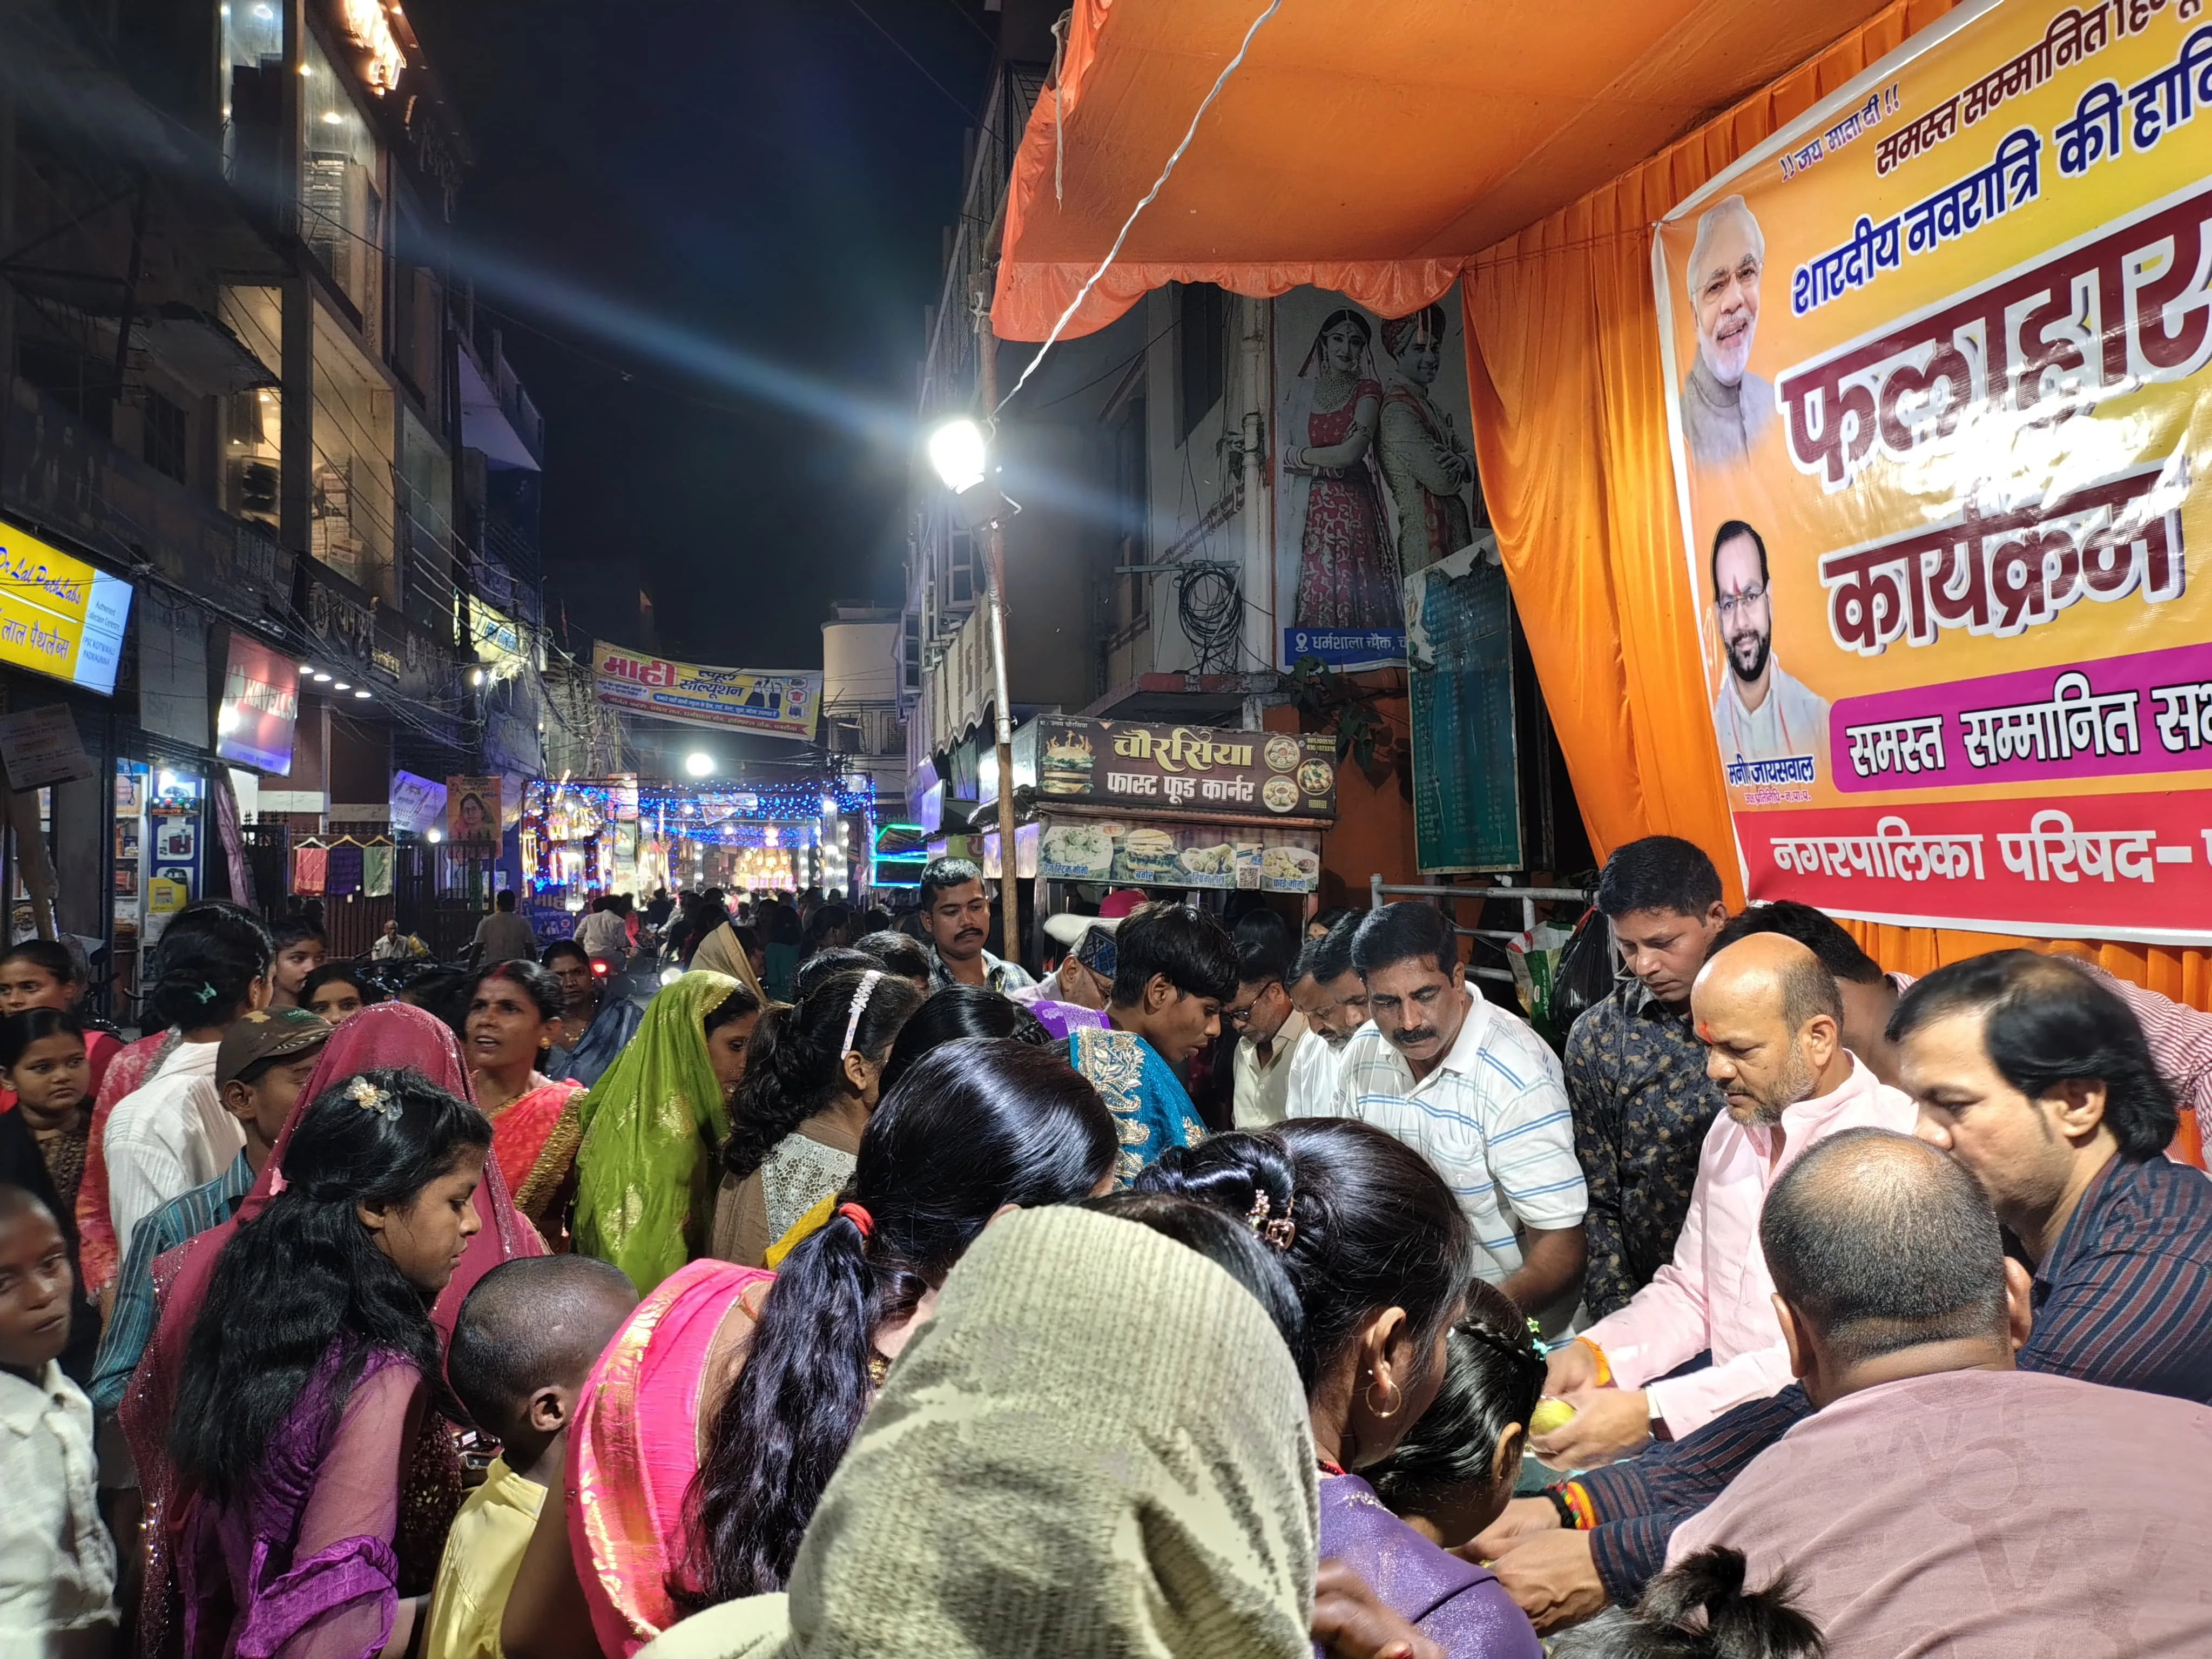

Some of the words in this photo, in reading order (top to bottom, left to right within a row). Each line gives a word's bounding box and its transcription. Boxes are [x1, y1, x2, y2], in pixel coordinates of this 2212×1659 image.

[1876, 95, 1960, 176] समस्त
[1963, 0, 2109, 125] सम्मानित
[1791, 217, 1900, 314] शारदीय
[1904, 128, 2041, 251] नवरात्रि
[2055, 82, 2123, 173] की
[11, 557, 36, 584] Lal
[2, 618, 28, 646] लाल
[1311, 632, 1365, 650] धर्मशाला
[603, 655, 676, 688] माही
[244, 679, 295, 721] HAVELLS
[679, 677, 745, 700] सॉल्यूशन
[1845, 714, 1945, 778] समस्त
[1959, 670, 2140, 770] सम्मानित
[1112, 727, 1253, 772] चौरसिया
[1751, 756, 1815, 783] जायसवाल
[1107, 772, 1159, 795] फास्ट
[1163, 775, 1197, 805] फूड
[1201, 774, 1256, 802] कार्नर
[1769, 816, 1985, 882] नगरपालिका
